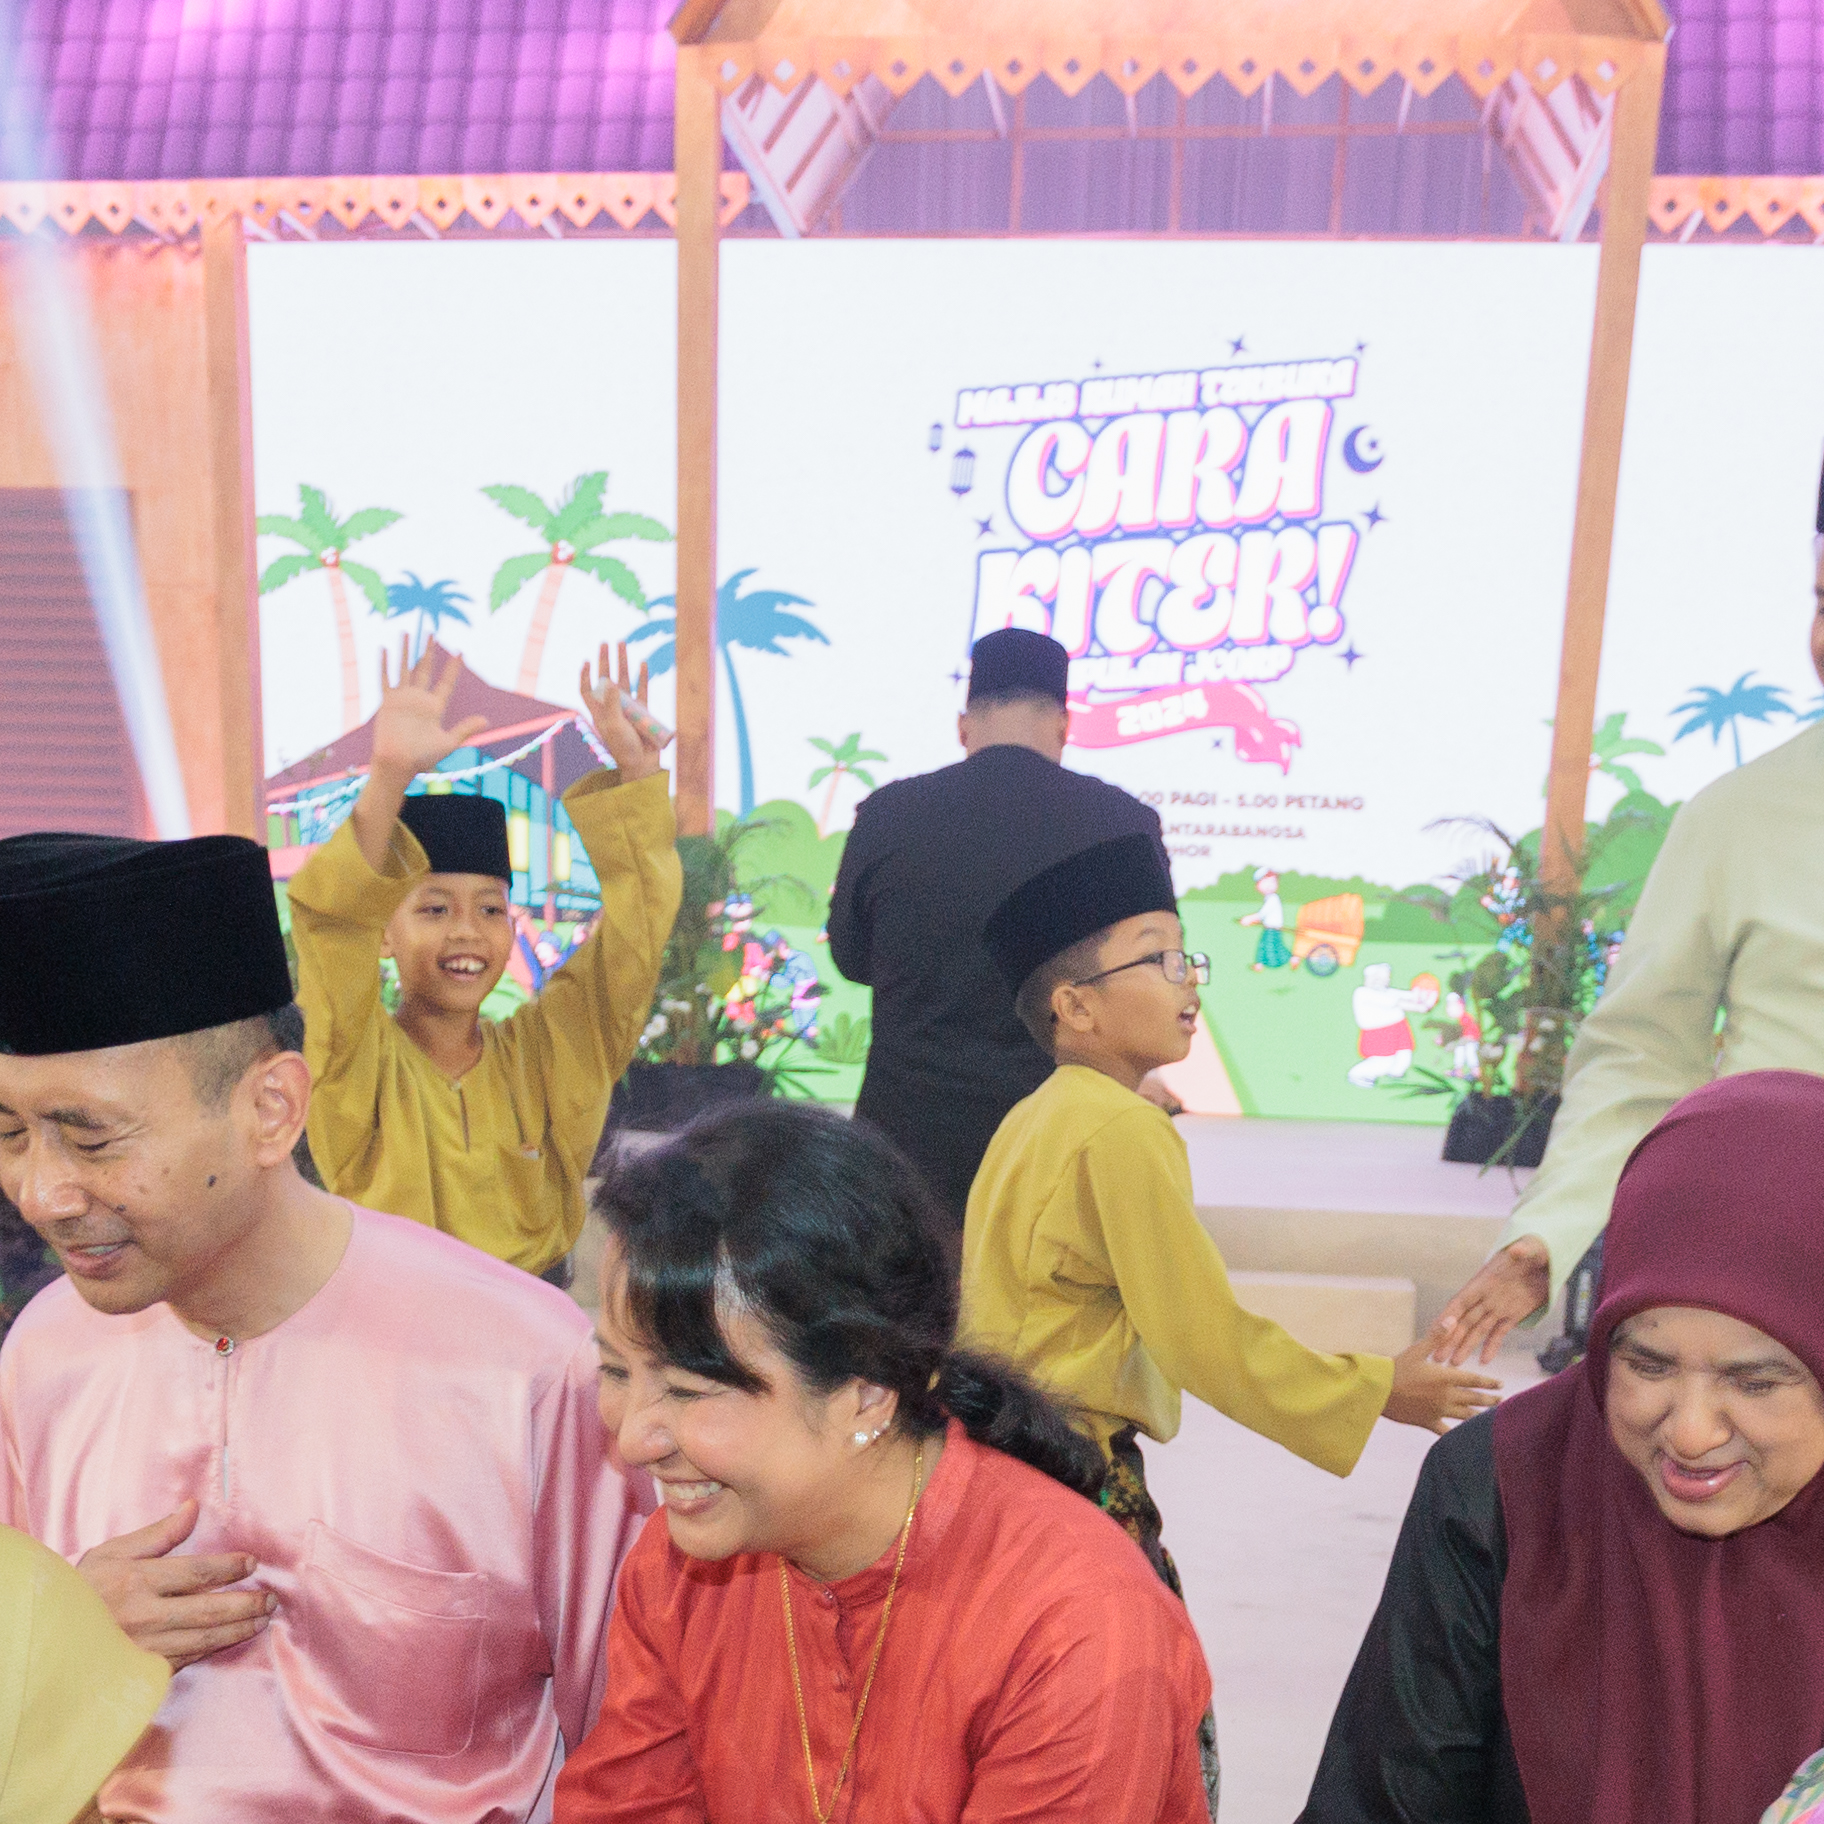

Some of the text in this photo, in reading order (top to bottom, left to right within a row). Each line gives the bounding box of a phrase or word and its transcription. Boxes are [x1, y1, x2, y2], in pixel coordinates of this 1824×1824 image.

[1007, 398, 1333, 541] CARA
[1116, 690, 1209, 736] 2024
[1170, 791, 1218, 807] PAGI
[1284, 795, 1365, 812] PETANG
